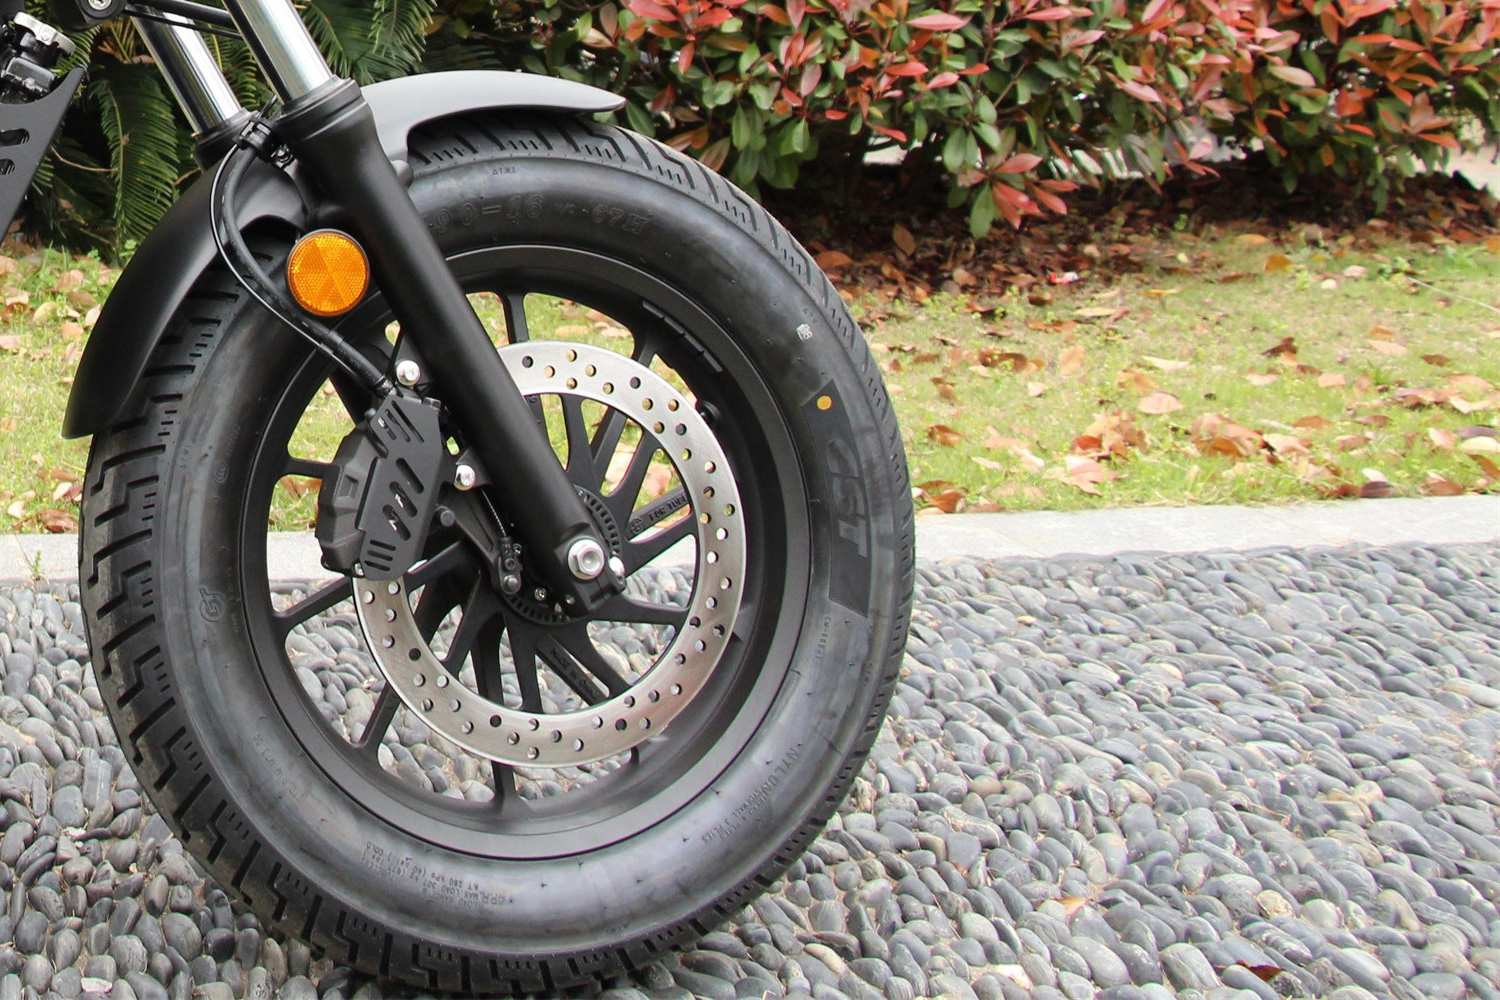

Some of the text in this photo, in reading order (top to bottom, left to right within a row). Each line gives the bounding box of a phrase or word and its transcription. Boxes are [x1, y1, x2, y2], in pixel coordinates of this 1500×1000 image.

[592, 204, 651, 235] 67H
[826, 438, 870, 559] CST
[760, 747, 797, 795] NYLON
[701, 824, 724, 843] PLIES
